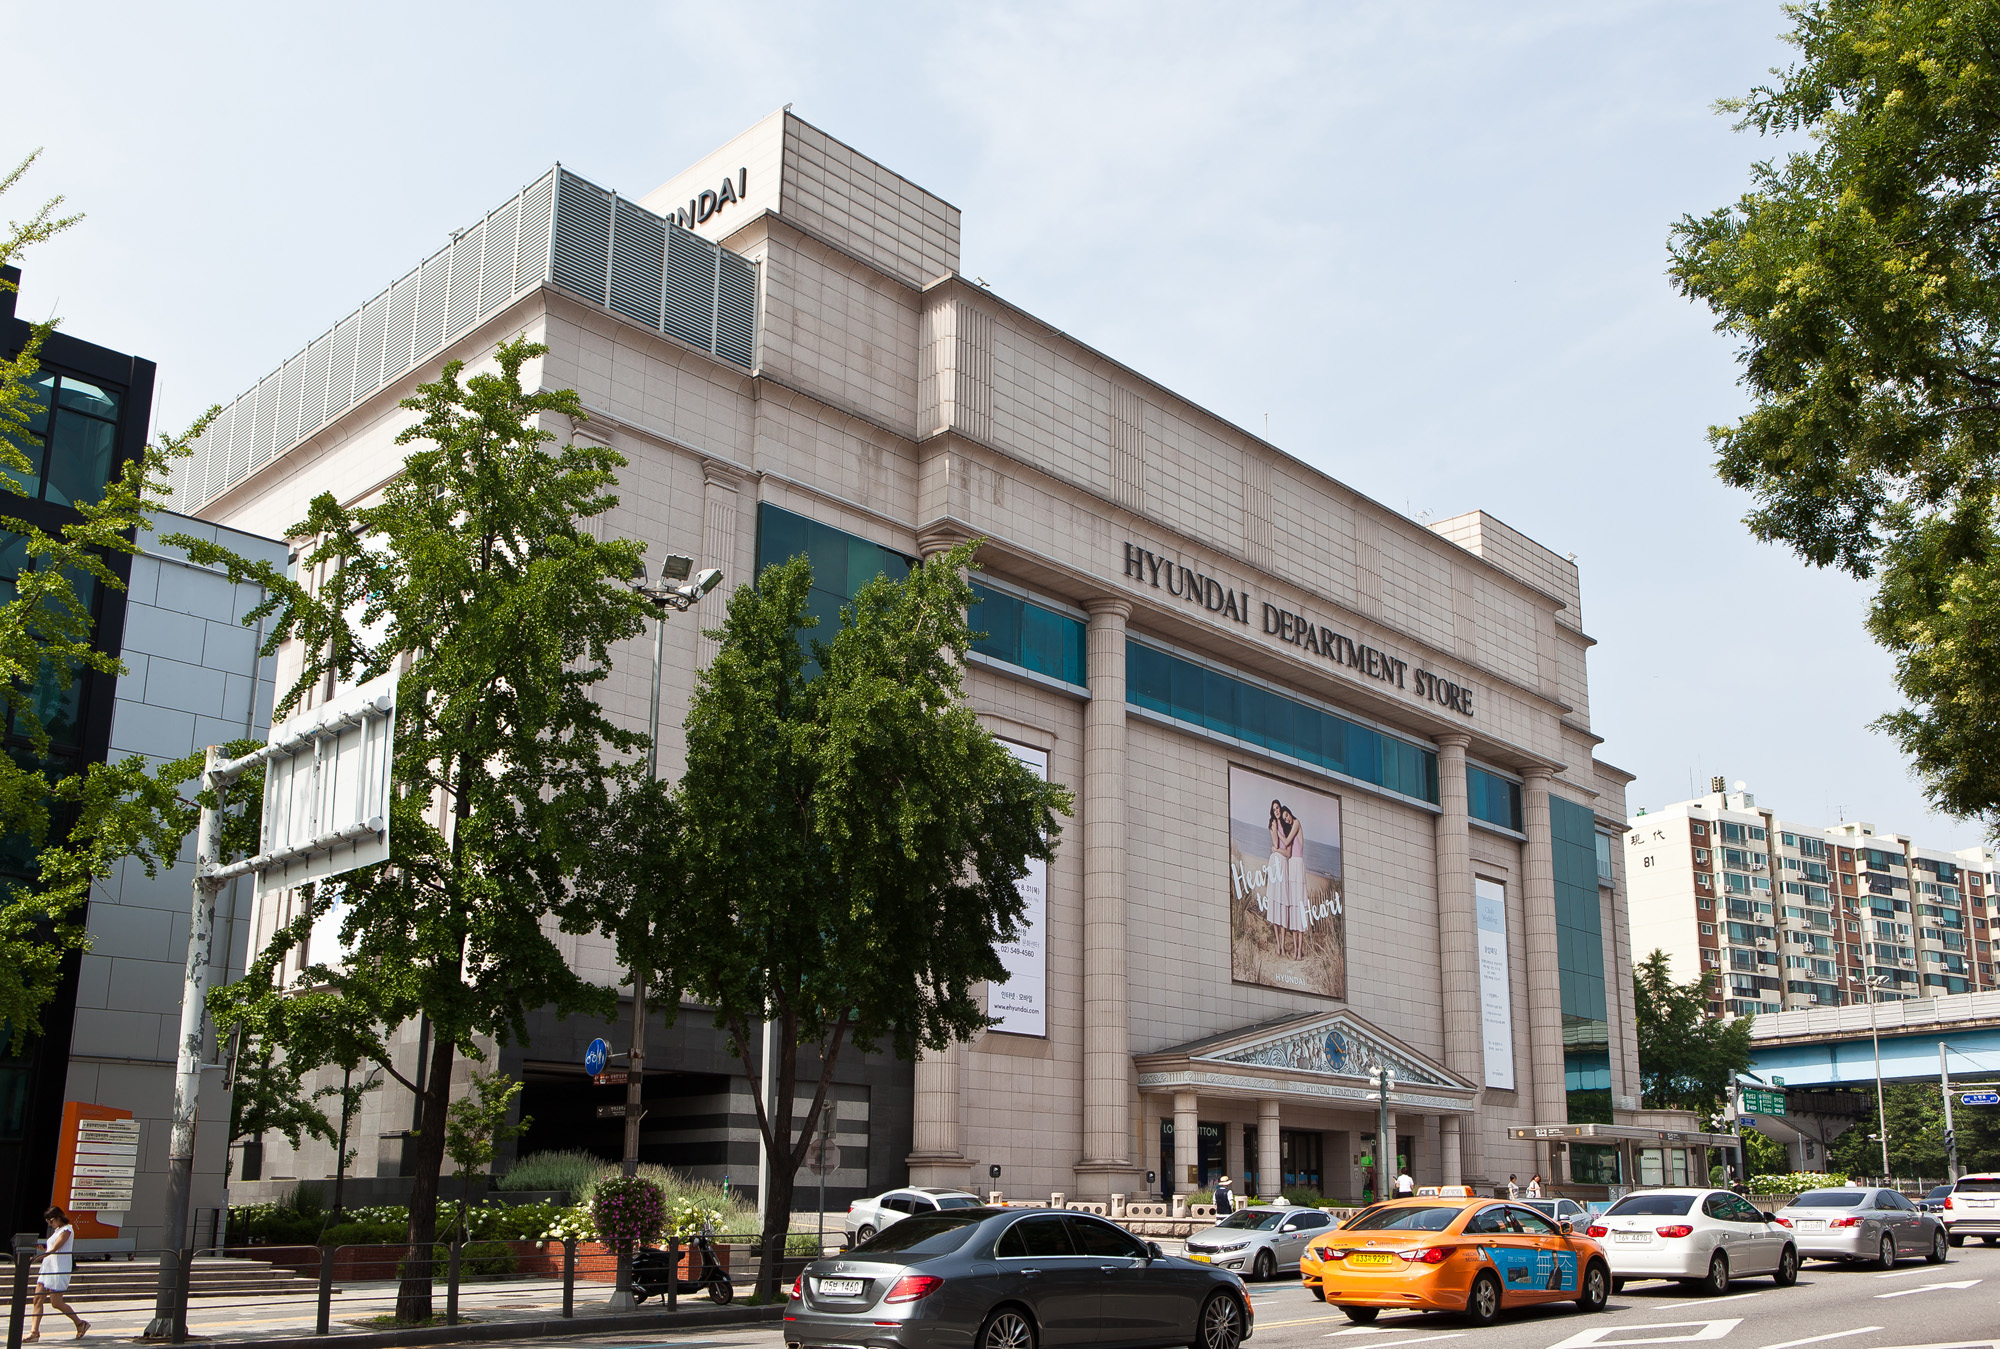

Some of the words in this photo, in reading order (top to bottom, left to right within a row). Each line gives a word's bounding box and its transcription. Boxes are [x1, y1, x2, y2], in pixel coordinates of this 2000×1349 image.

[668, 167, 747, 230] NDAI
[1124, 541, 1249, 625] HYUNDAI
[1262, 602, 1407, 690] DEPARTMENT
[1414, 668, 1474, 717] STORE
[1643, 855, 1655, 868] 81
[1231, 856, 1285, 900] Heart
[1256, 892, 1269, 912] to
[1300, 891, 1343, 931] Heart
[1010, 946, 1035, 958] 549-4560
[1275, 973, 1307, 986] HYUNDAI
[1001, 991, 1016, 1001] 인터넷
[994, 1004, 1040, 1015] www.ehyundai.com
[1331, 1087, 1363, 1098] DEPARTMENT
[1631, 1234, 1648, 1242] 4470
[1372, 1254, 1389, 1262] 9291
[841, 1281, 860, 1292] 1460
